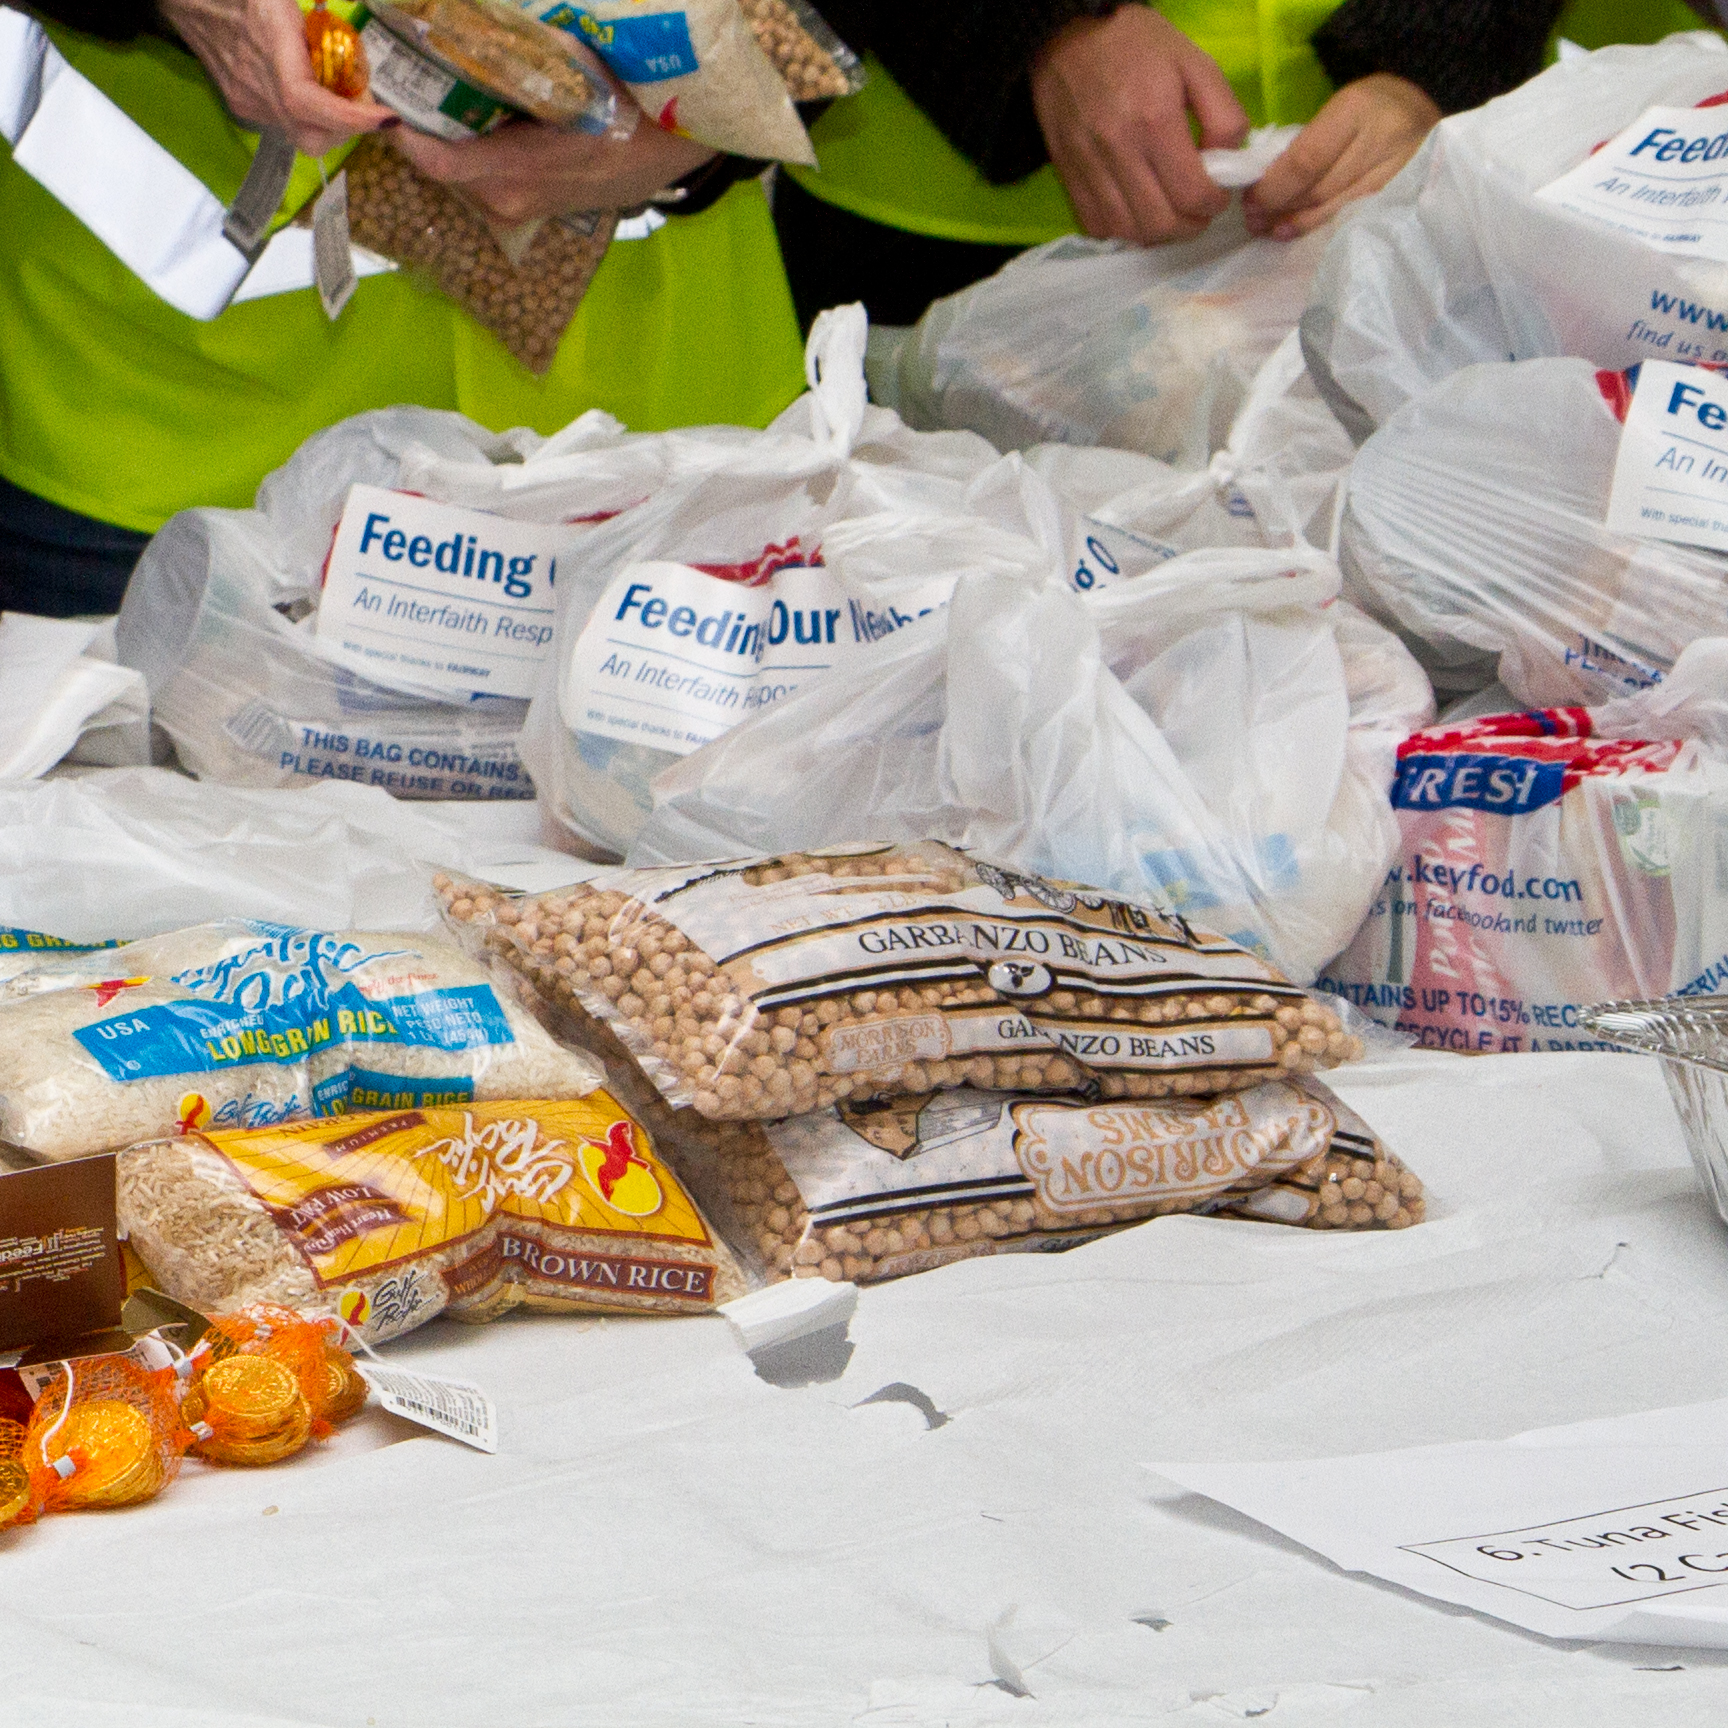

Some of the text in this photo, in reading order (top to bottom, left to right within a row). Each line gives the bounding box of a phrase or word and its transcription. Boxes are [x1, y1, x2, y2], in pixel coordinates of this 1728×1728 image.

[1595, 176, 1719, 206] An Interfaith
[1627, 320, 1703, 357] find us
[1655, 445, 1695, 475] An
[1641, 505, 1709, 531] With special
[359, 512, 537, 599] Feeding
[353, 587, 487, 635] An Interfaith
[768, 599, 841, 644] Our
[600, 653, 632, 678] An
[635, 661, 739, 709] Interfaith
[302, 727, 520, 780] THIS BAG CONTAINS
[280, 751, 364, 780] PLEASE
[371, 768, 445, 792] REUSE
[451, 776, 481, 794] OR
[1061, 934, 1167, 965] BEANS
[392, 1004, 417, 1018] NET
[444, 1010, 482, 1025] NETO
[1423, 988, 1530, 1025] UP TO 15%
[96, 1019, 151, 1040] USA
[200, 1014, 264, 1038] ENRICHED
[205, 1030, 273, 1063] LONG
[1130, 1037, 1215, 1059] BEANS
[353, 1088, 470, 1108] GRAIN RICE
[334, 1118, 409, 1154] PREMIUM
[414, 1111, 566, 1189] Pacific
[457, 1140, 574, 1213] Gulf
[289, 1186, 371, 1227] LOW FAT
[351, 1208, 393, 1230] Heart
[501, 1237, 625, 1289] BROWN
[633, 1265, 706, 1294] RICE
[1477, 1524, 1671, 1563] 6. Tuna
[1610, 1563, 1686, 1584] (2
